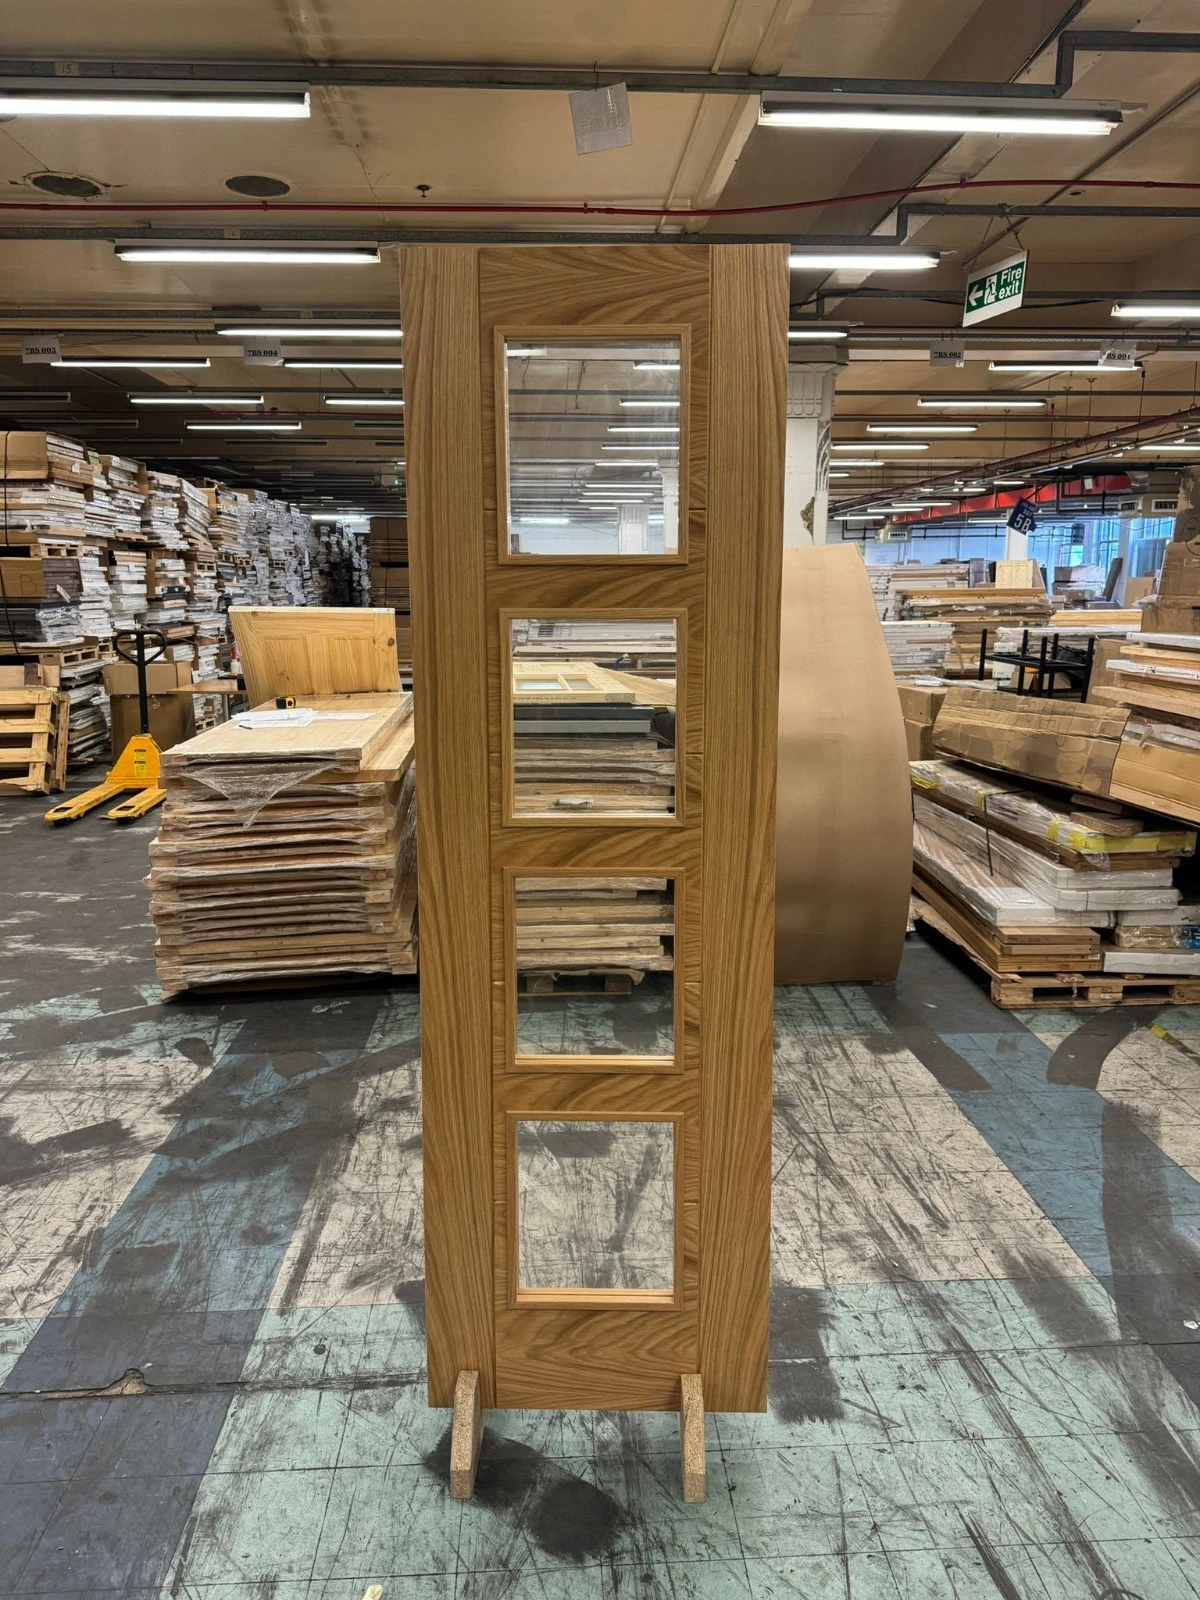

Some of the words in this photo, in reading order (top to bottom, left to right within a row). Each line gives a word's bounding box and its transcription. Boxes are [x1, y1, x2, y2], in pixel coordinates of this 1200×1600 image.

[1000, 267, 1022, 286] Fire
[998, 280, 1020, 300] exit
[1013, 512, 1032, 533] 5B
